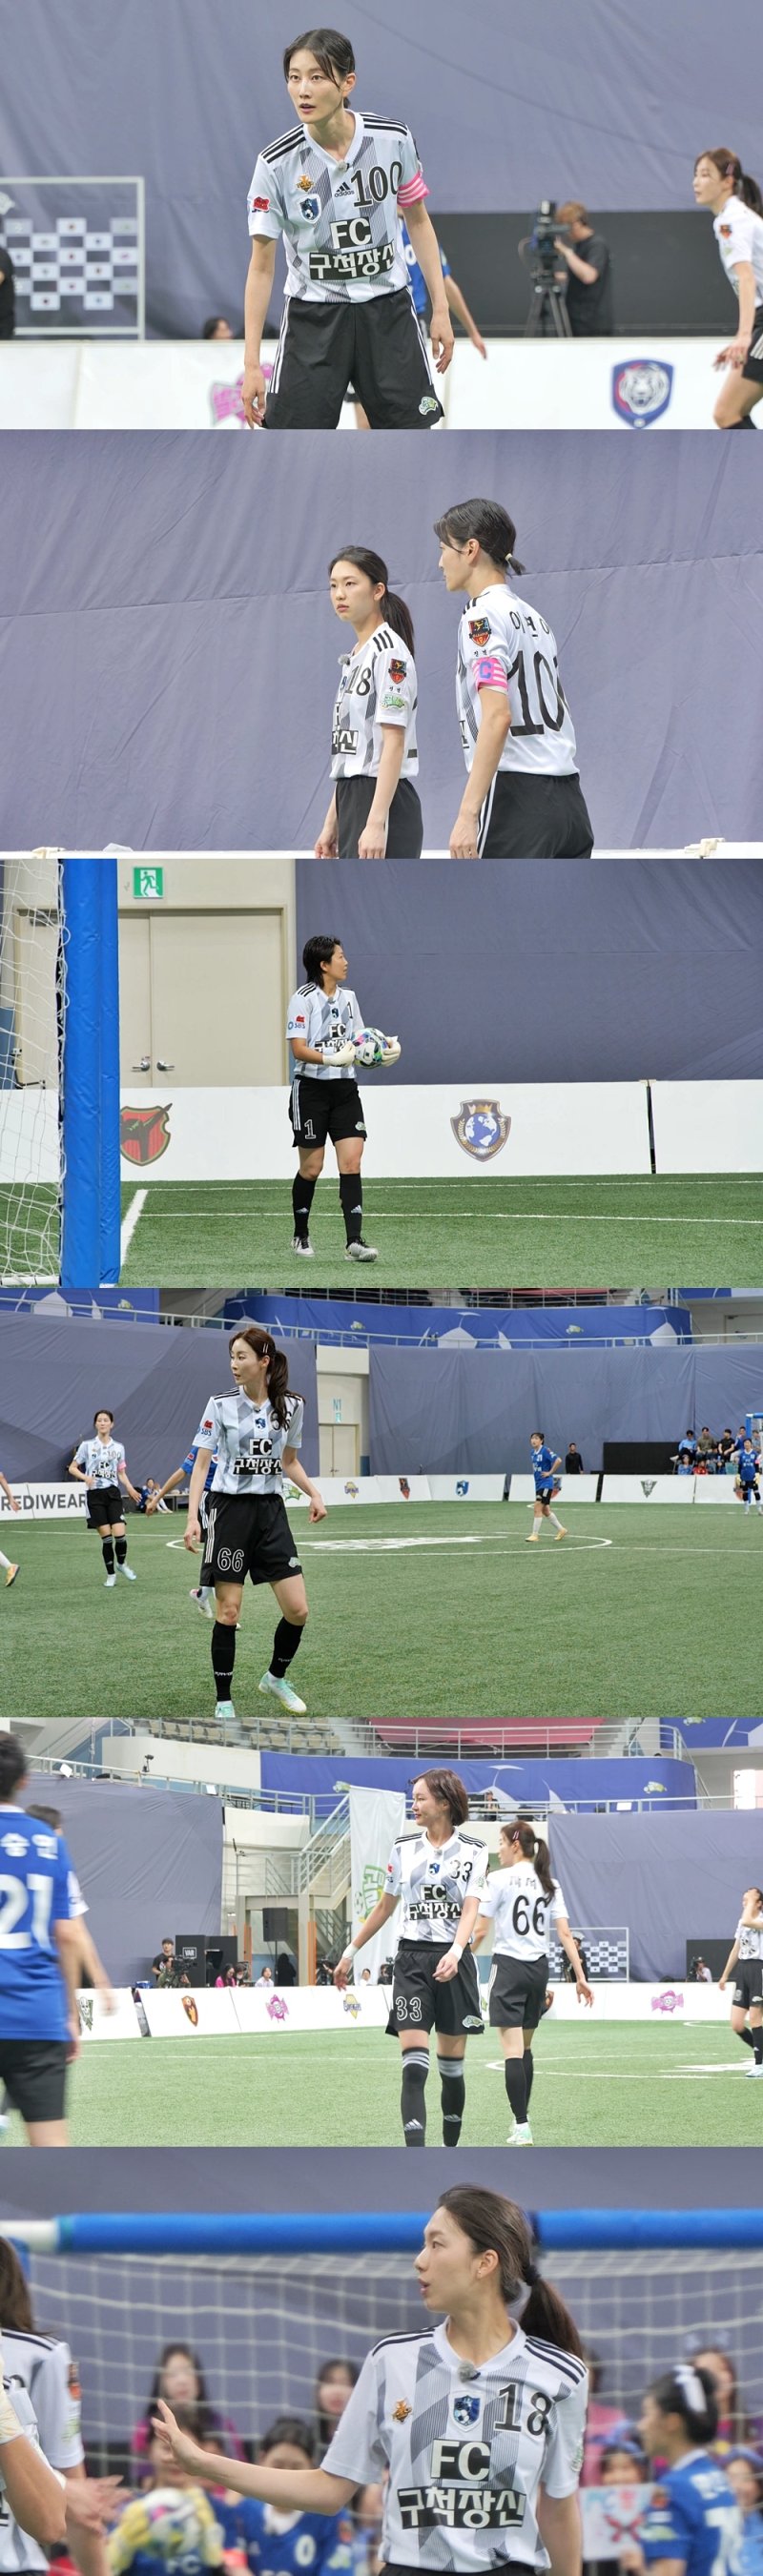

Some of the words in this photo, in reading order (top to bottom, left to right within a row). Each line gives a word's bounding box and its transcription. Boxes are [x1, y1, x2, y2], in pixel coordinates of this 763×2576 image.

[351, 161, 402, 207] 100
[330, 218, 372, 249] FC
[344, 664, 372, 696] 18
[480, 662, 492, 679] C
[347, 1001, 354, 1019] 1
[330, 1024, 346, 1038] FC
[304, 1119, 317, 1139] 1
[249, 1438, 273, 1456] FC
[217, 1547, 244, 1572] 66
[449, 1859, 473, 1882] 33
[421, 1884, 446, 1901] FC
[0, 1873, 54, 1953] 21
[512, 1894, 548, 1936] 66
[395, 1996, 423, 2021] 33
[494, 2383, 553, 2437] 18
[430, 2439, 491, 2482] FC
[397, 2487, 528, 2528] 구척장신
